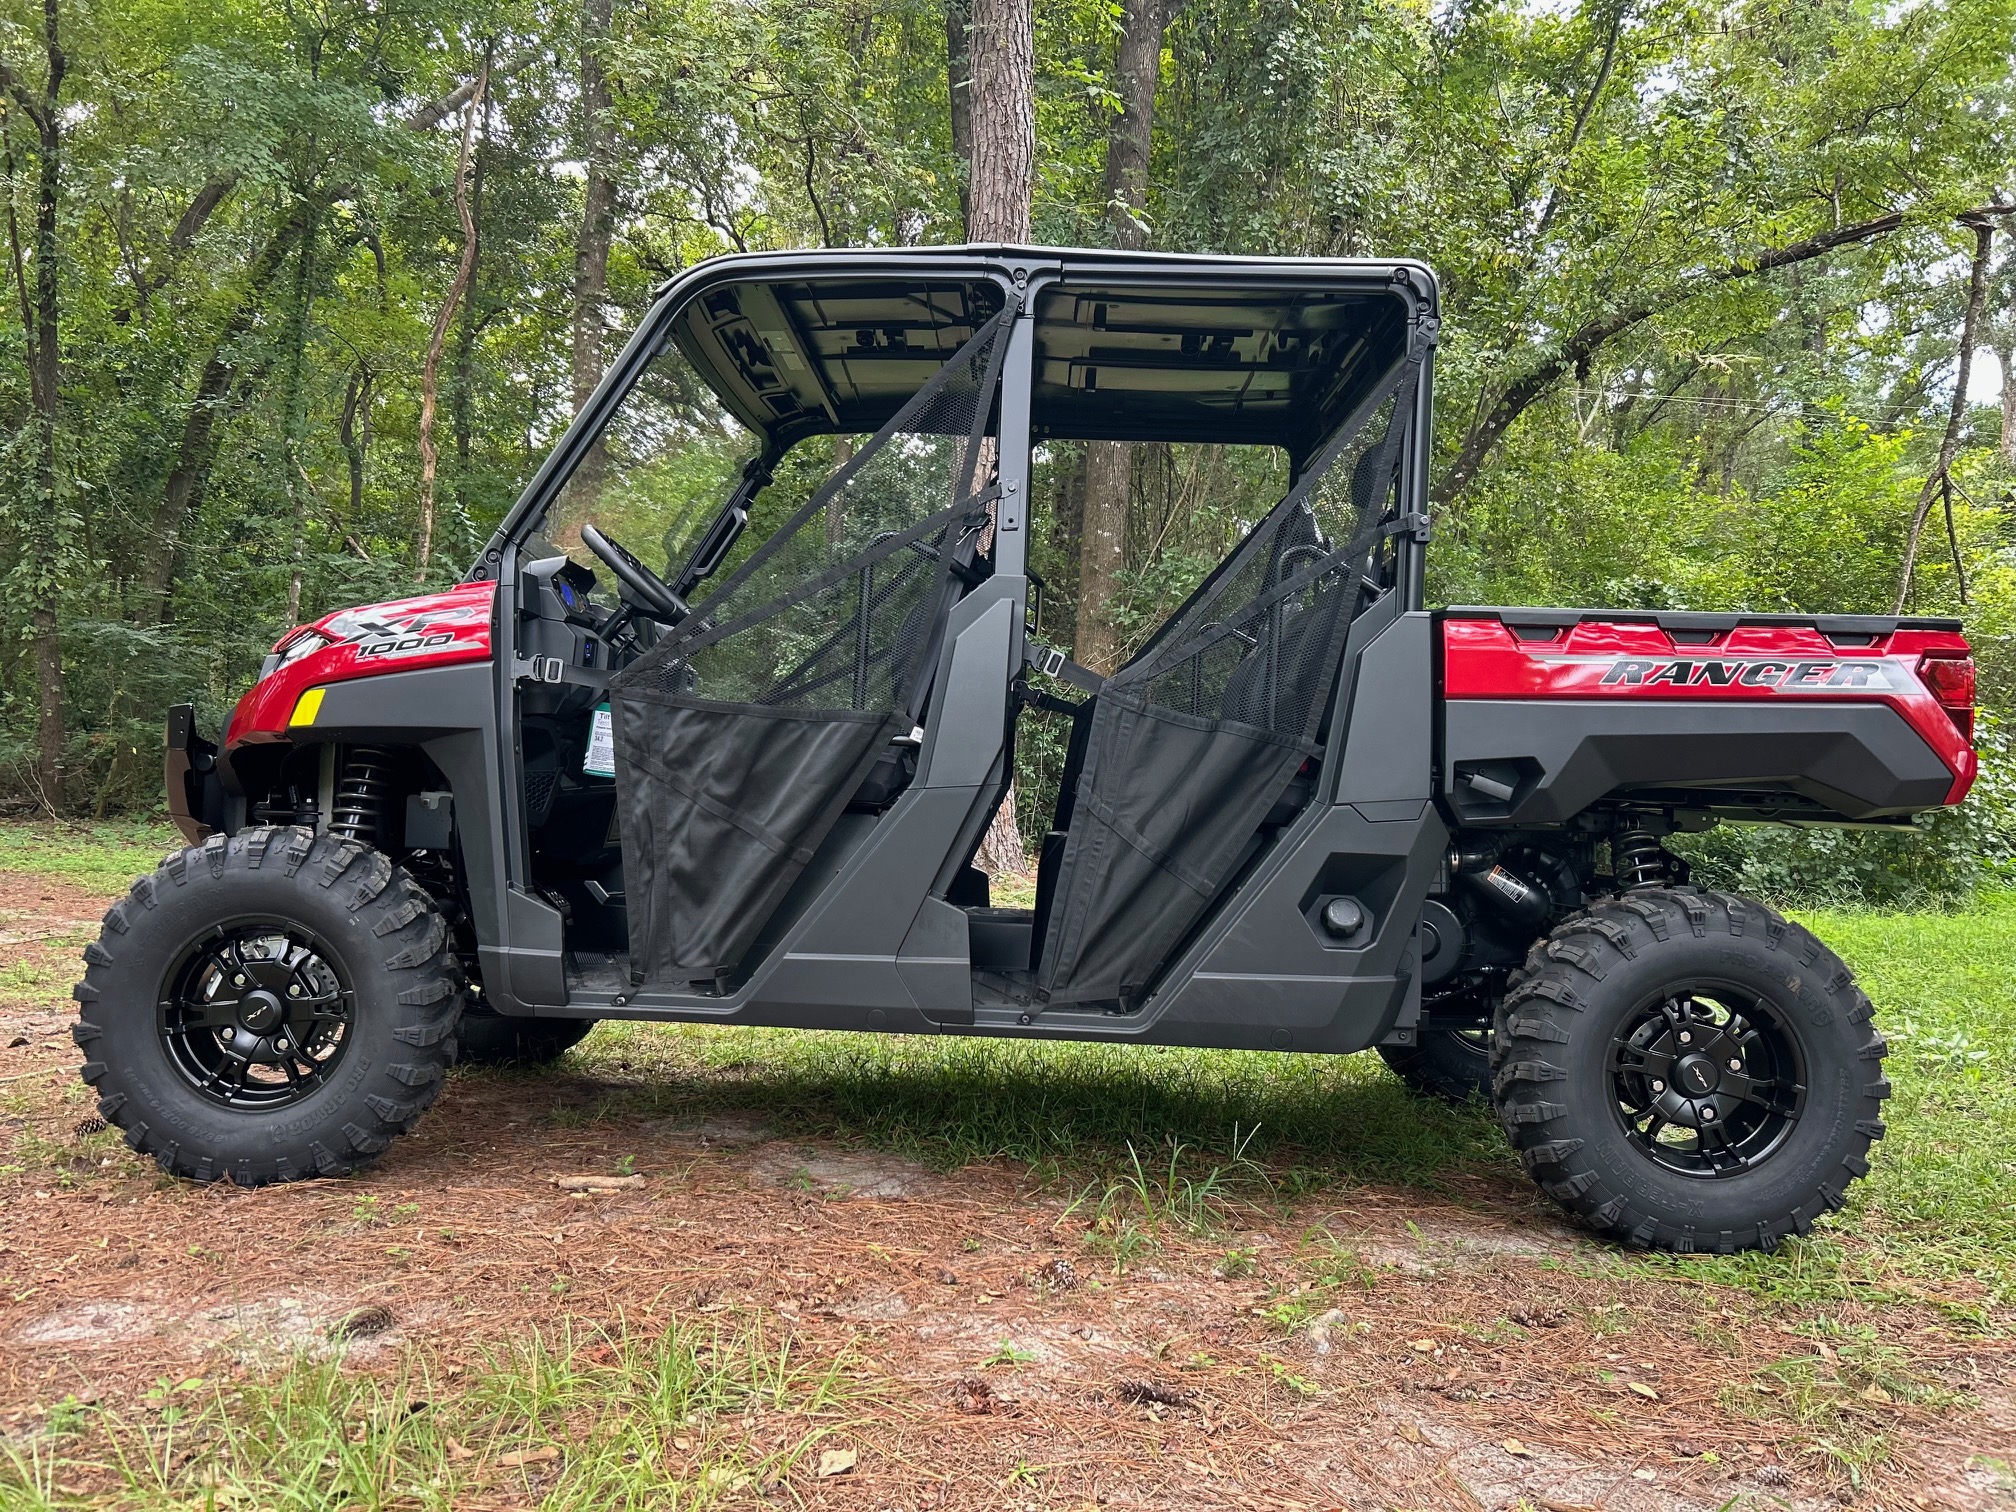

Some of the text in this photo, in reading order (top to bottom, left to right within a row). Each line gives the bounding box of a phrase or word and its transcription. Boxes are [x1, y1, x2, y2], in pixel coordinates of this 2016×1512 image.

[338, 606, 476, 645] XP
[357, 633, 455, 658] 1000
[1600, 660, 1883, 688] RANGER
[1720, 949, 1819, 1011] PRO ARMOR
[288, 1056, 372, 1137] PRO ARMOR
[1594, 1138, 1704, 1218] X-TERRAIN
